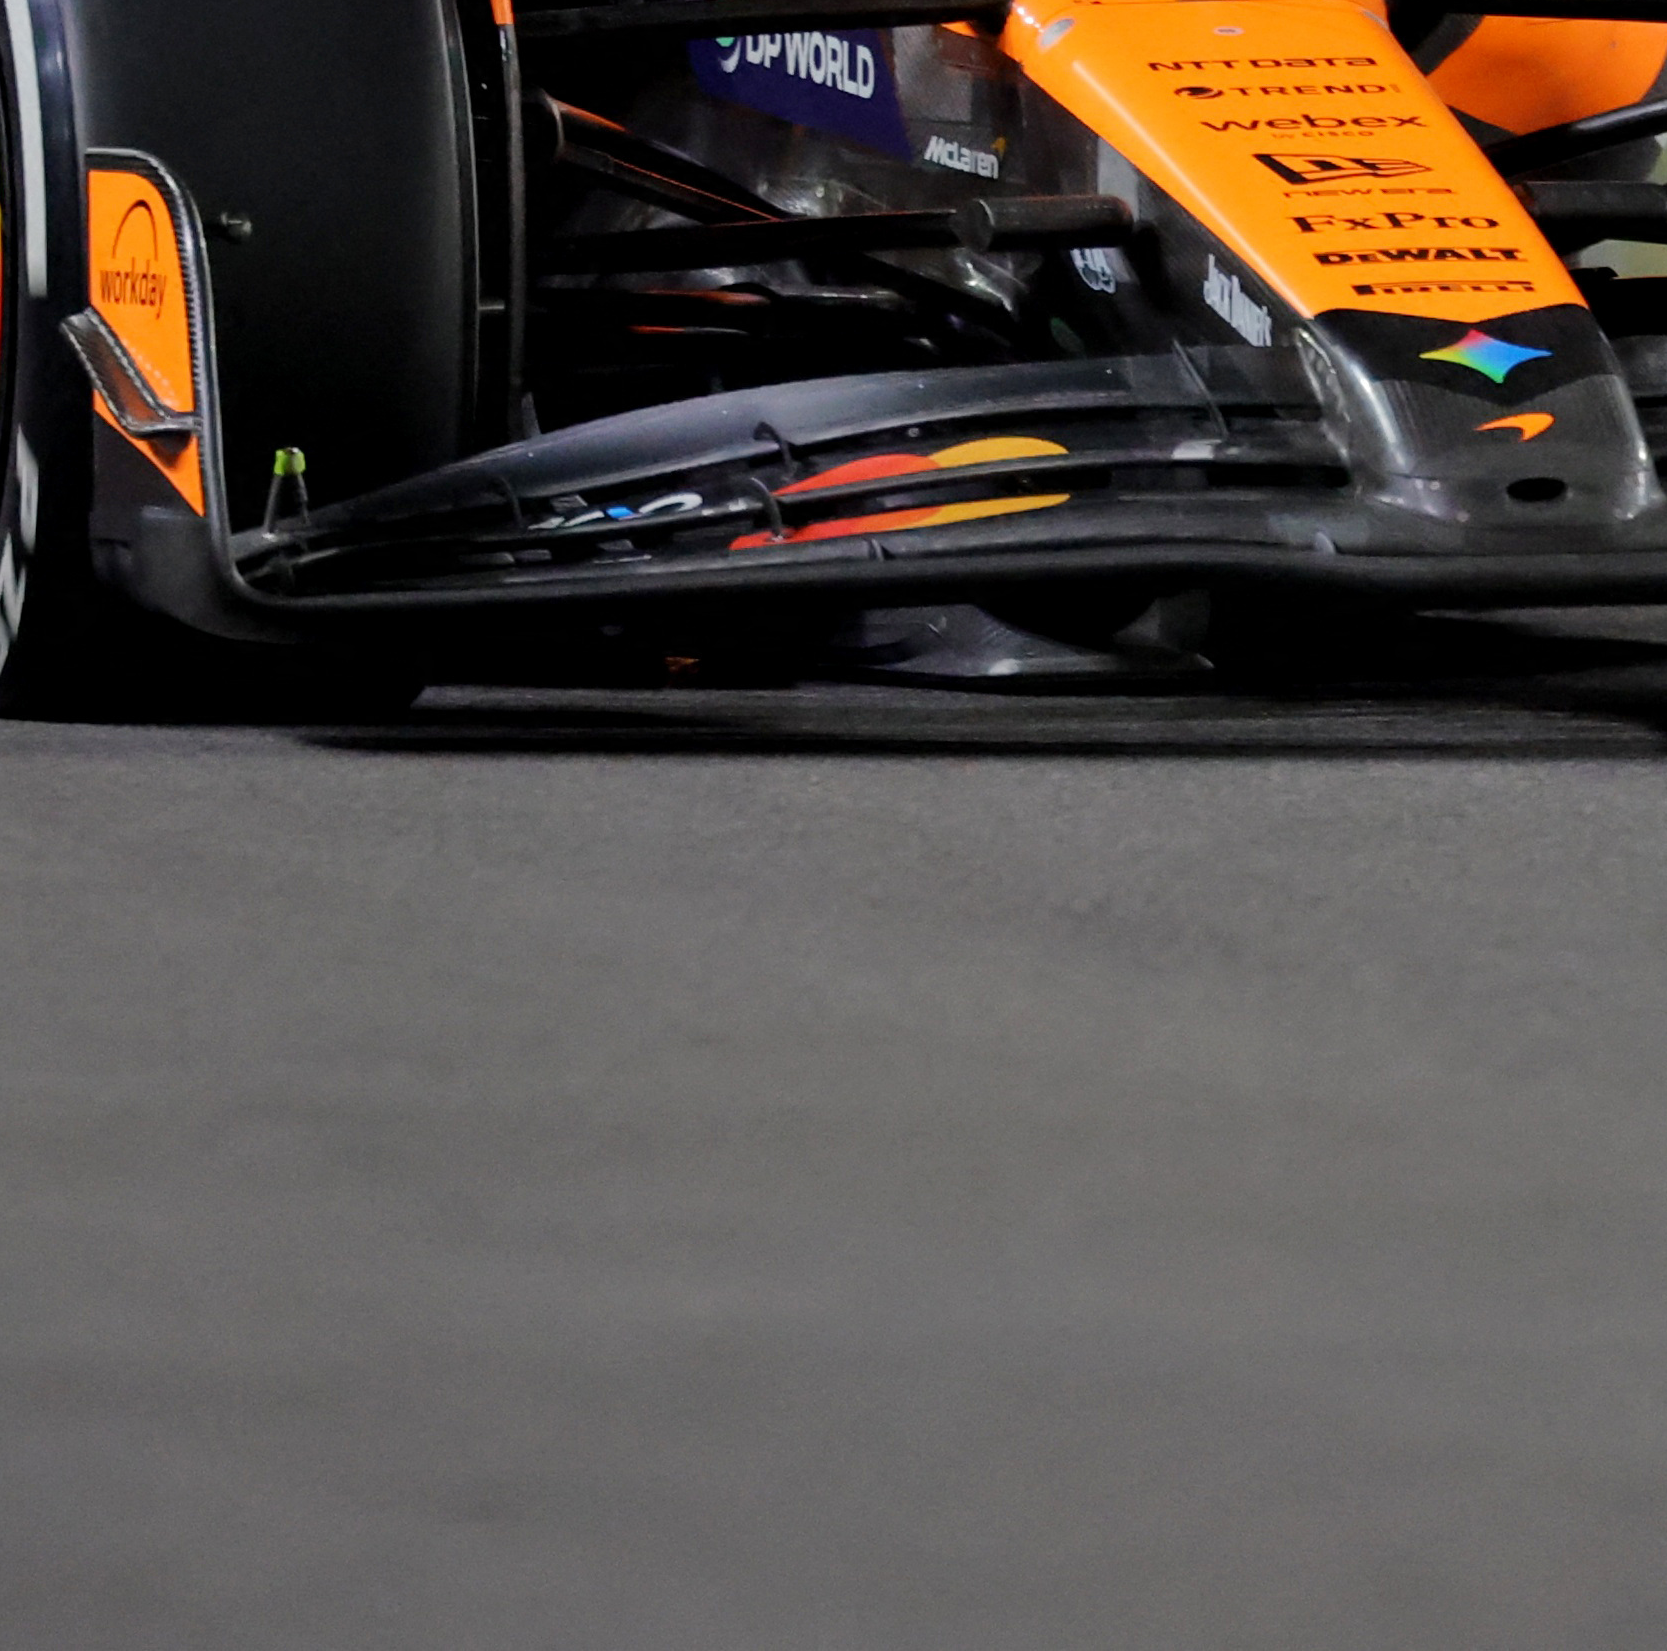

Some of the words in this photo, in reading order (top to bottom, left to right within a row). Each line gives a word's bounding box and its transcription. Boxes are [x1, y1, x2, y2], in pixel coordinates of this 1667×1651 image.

[784, 31, 875, 99] WORLD
[1147, 59, 1239, 72] NTT
[1230, 83, 1387, 97] TREND
[1199, 113, 1427, 133] webex
[923, 134, 1000, 180] McLaren
[1285, 211, 1500, 233] FxPro
[100, 256, 167, 321] workday
